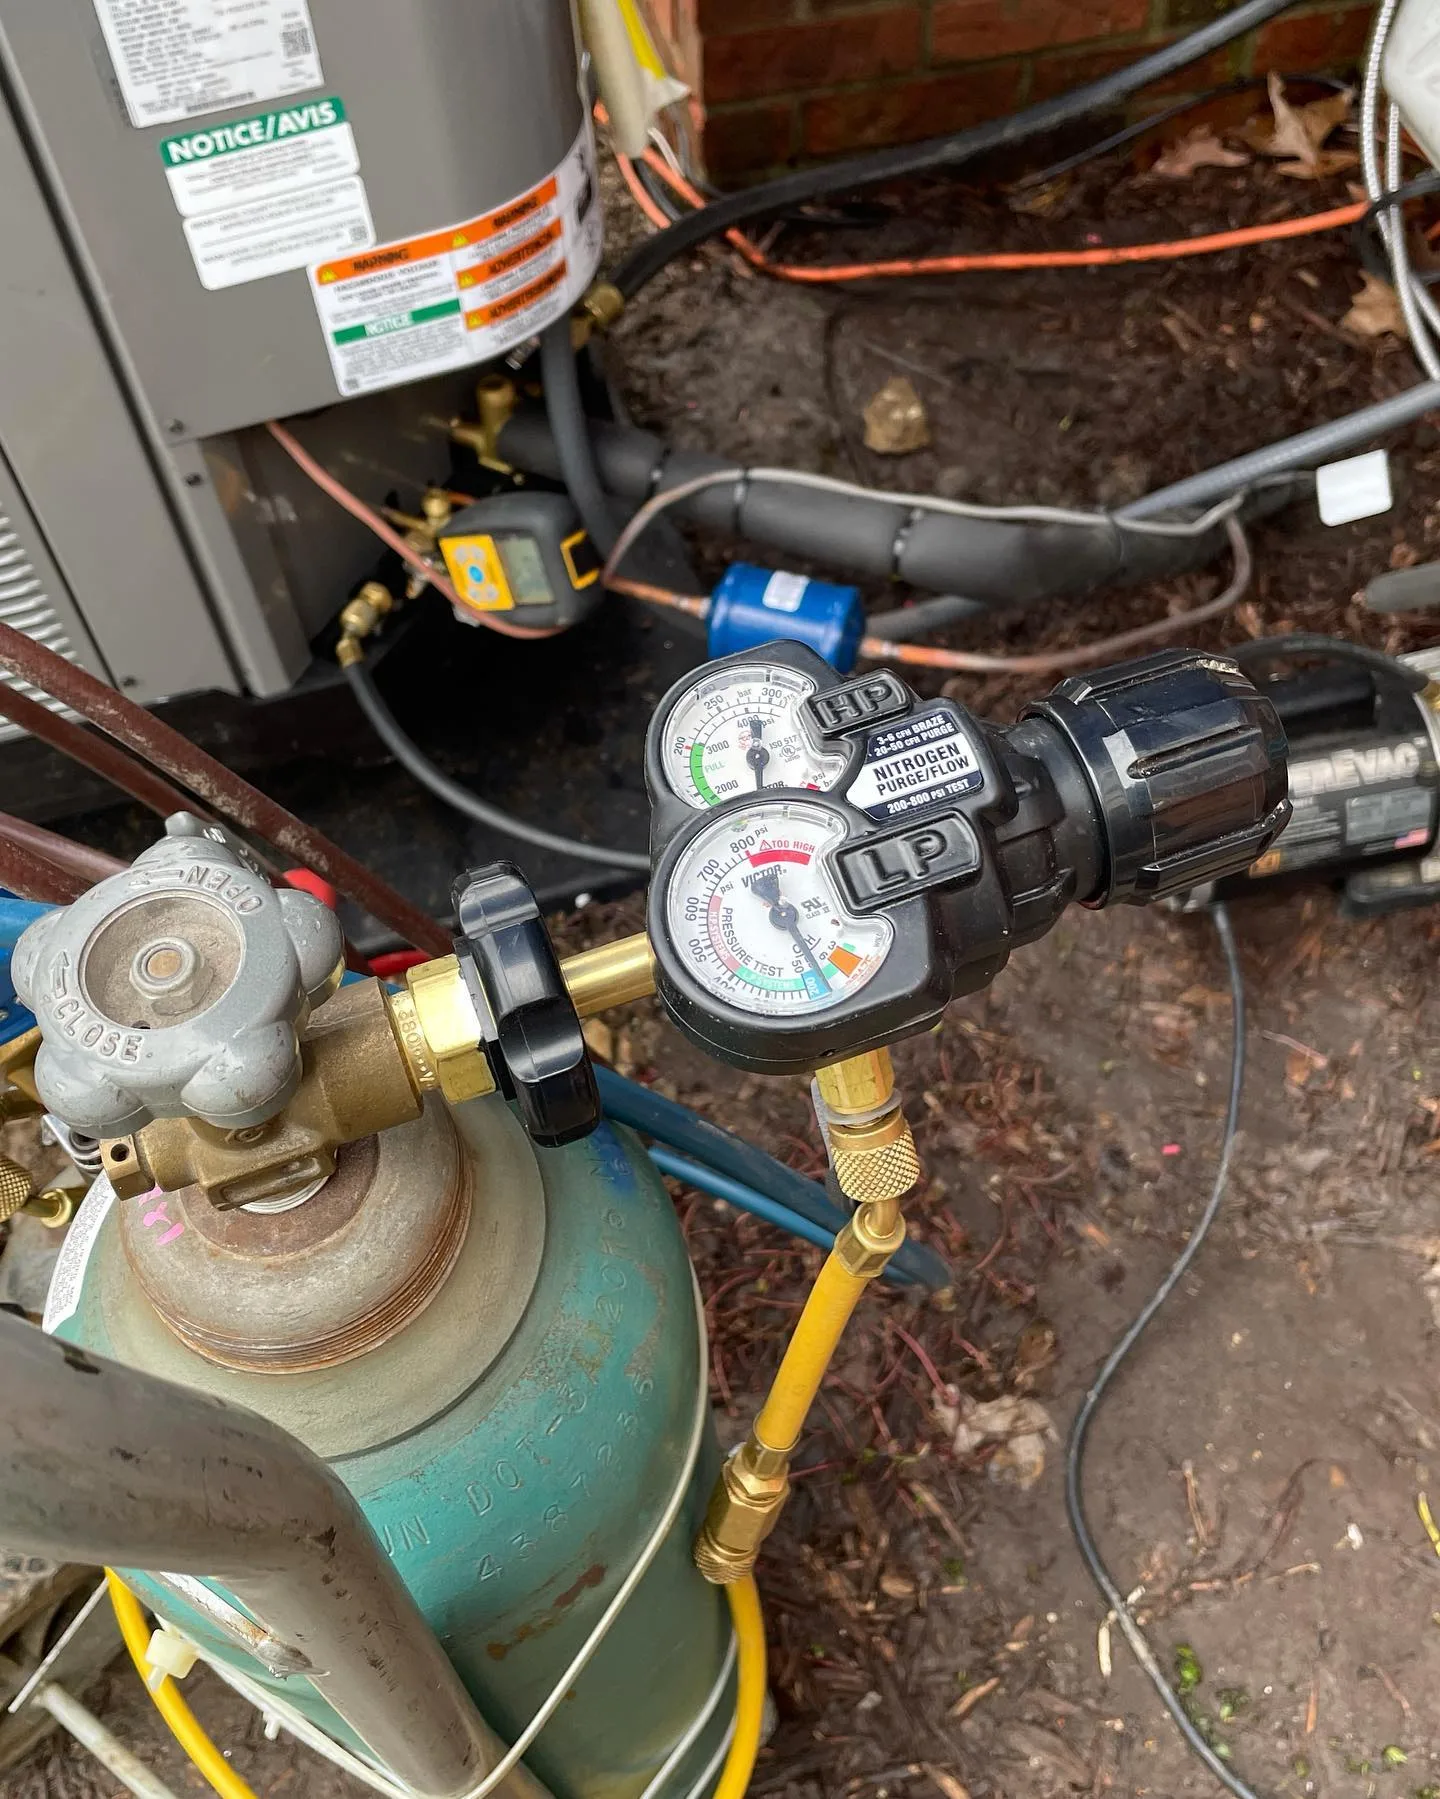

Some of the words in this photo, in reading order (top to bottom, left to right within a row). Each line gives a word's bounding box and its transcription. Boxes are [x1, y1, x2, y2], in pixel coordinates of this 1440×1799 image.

[166, 101, 337, 164] NOTICE/AVIS
[703, 695, 724, 710] 250
[737, 687, 752, 699] bar
[762, 688, 782, 699] 300
[817, 680, 892, 725] HP
[762, 717, 775, 730] psi
[876, 732, 896, 745] 3-6
[895, 728, 912, 740] CFH
[911, 714, 946, 733] BRAZE
[673, 736, 686, 756] 200
[706, 740, 730, 755] 3000
[784, 734, 799, 745] 517
[874, 741, 904, 757] 20-50
[905, 735, 921, 747] CFH
[920, 722, 955, 741] PURGE
[705, 761, 726, 773] FULL
[872, 742, 961, 781] NITROGEN
[714, 779, 739, 795] 2000
[876, 755, 970, 796] PURGE/FLOW
[887, 792, 931, 814] 200-800
[930, 788, 946, 800] PSI
[944, 778, 970, 795] TEST
[729, 835, 755, 854] 800
[754, 827, 769, 838] psi
[772, 840, 790, 850] TOO
[793, 841, 816, 854] HIGH
[696, 859, 720, 882] 700
[861, 829, 948, 892] LP
[184, 865, 264, 915] OPEN
[720, 882, 734, 894] psi
[685, 896, 700, 921] 600
[689, 938, 707, 963] 500
[722, 907, 755, 966] PRESSURE
[753, 958, 785, 978] TEST
[828, 940, 837, 950] 3
[792, 960, 805, 974] 50
[818, 951, 828, 961] 6
[53, 999, 143, 1063] CLOSE
